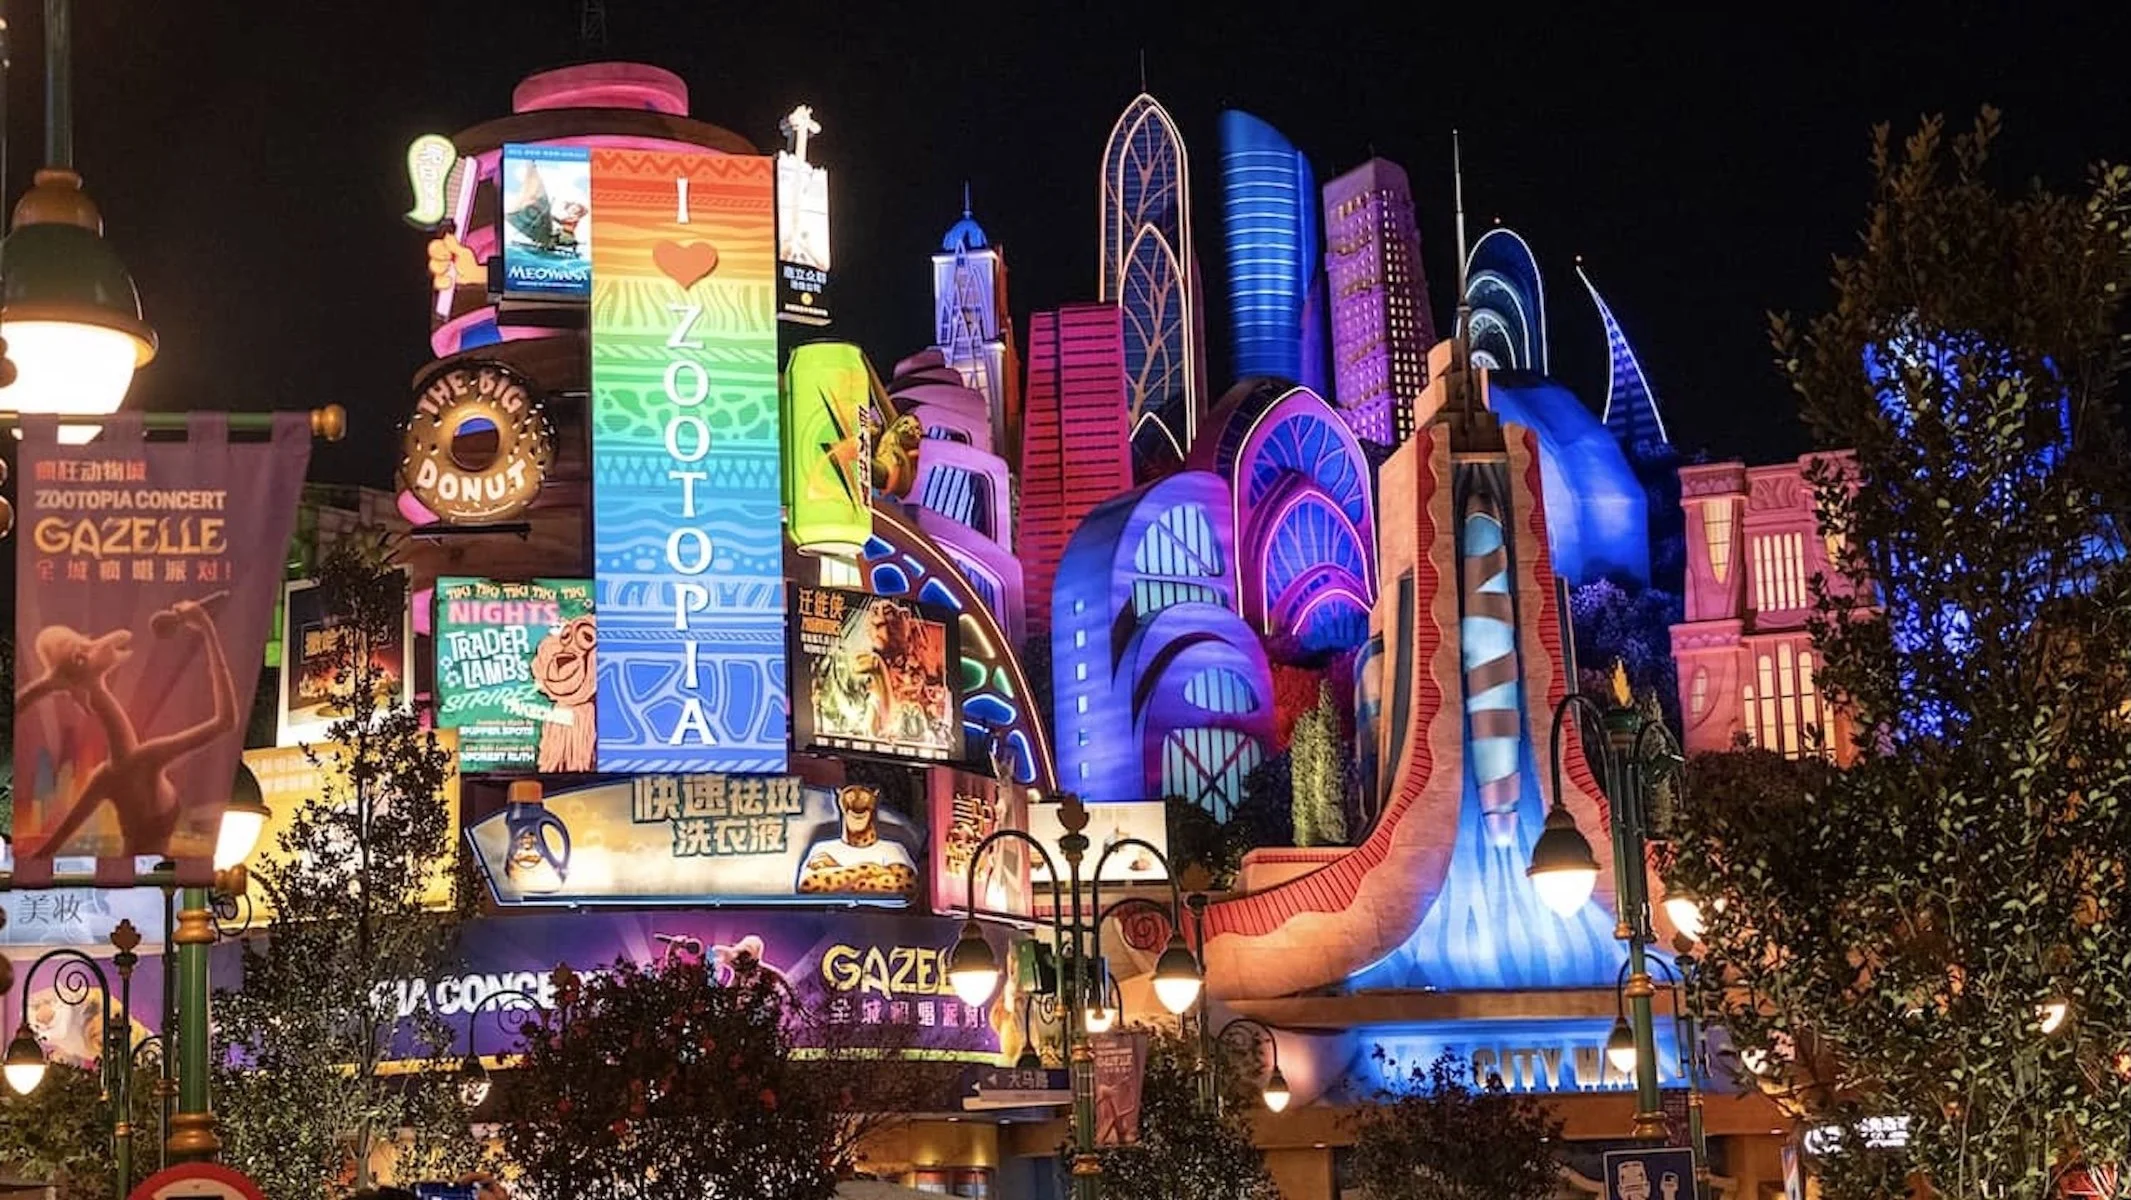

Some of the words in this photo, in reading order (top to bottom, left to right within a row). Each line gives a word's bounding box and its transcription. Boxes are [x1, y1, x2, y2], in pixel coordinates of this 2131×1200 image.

[676, 174, 691, 225] I
[416, 370, 468, 415] THE
[478, 368, 524, 414] BIG
[35, 489, 133, 510] ZOOTOPIA
[134, 490, 227, 511] CONCERT
[416, 457, 527, 502] DONUT
[34, 515, 227, 560] GAZELLE
[662, 301, 717, 747] ZOOTOPIA
[445, 584, 471, 600] TIKI
[503, 585, 529, 599] TIKI
[561, 586, 587, 599] TIKI
[448, 600, 559, 625] NIGHTS
[445, 625, 530, 662] TRADER
[633, 773, 802, 823] 快速祛斑
[673, 817, 787, 857] 洗衣液
[19, 893, 83, 925] 美妆
[1471, 1048, 1562, 1093] CITY
